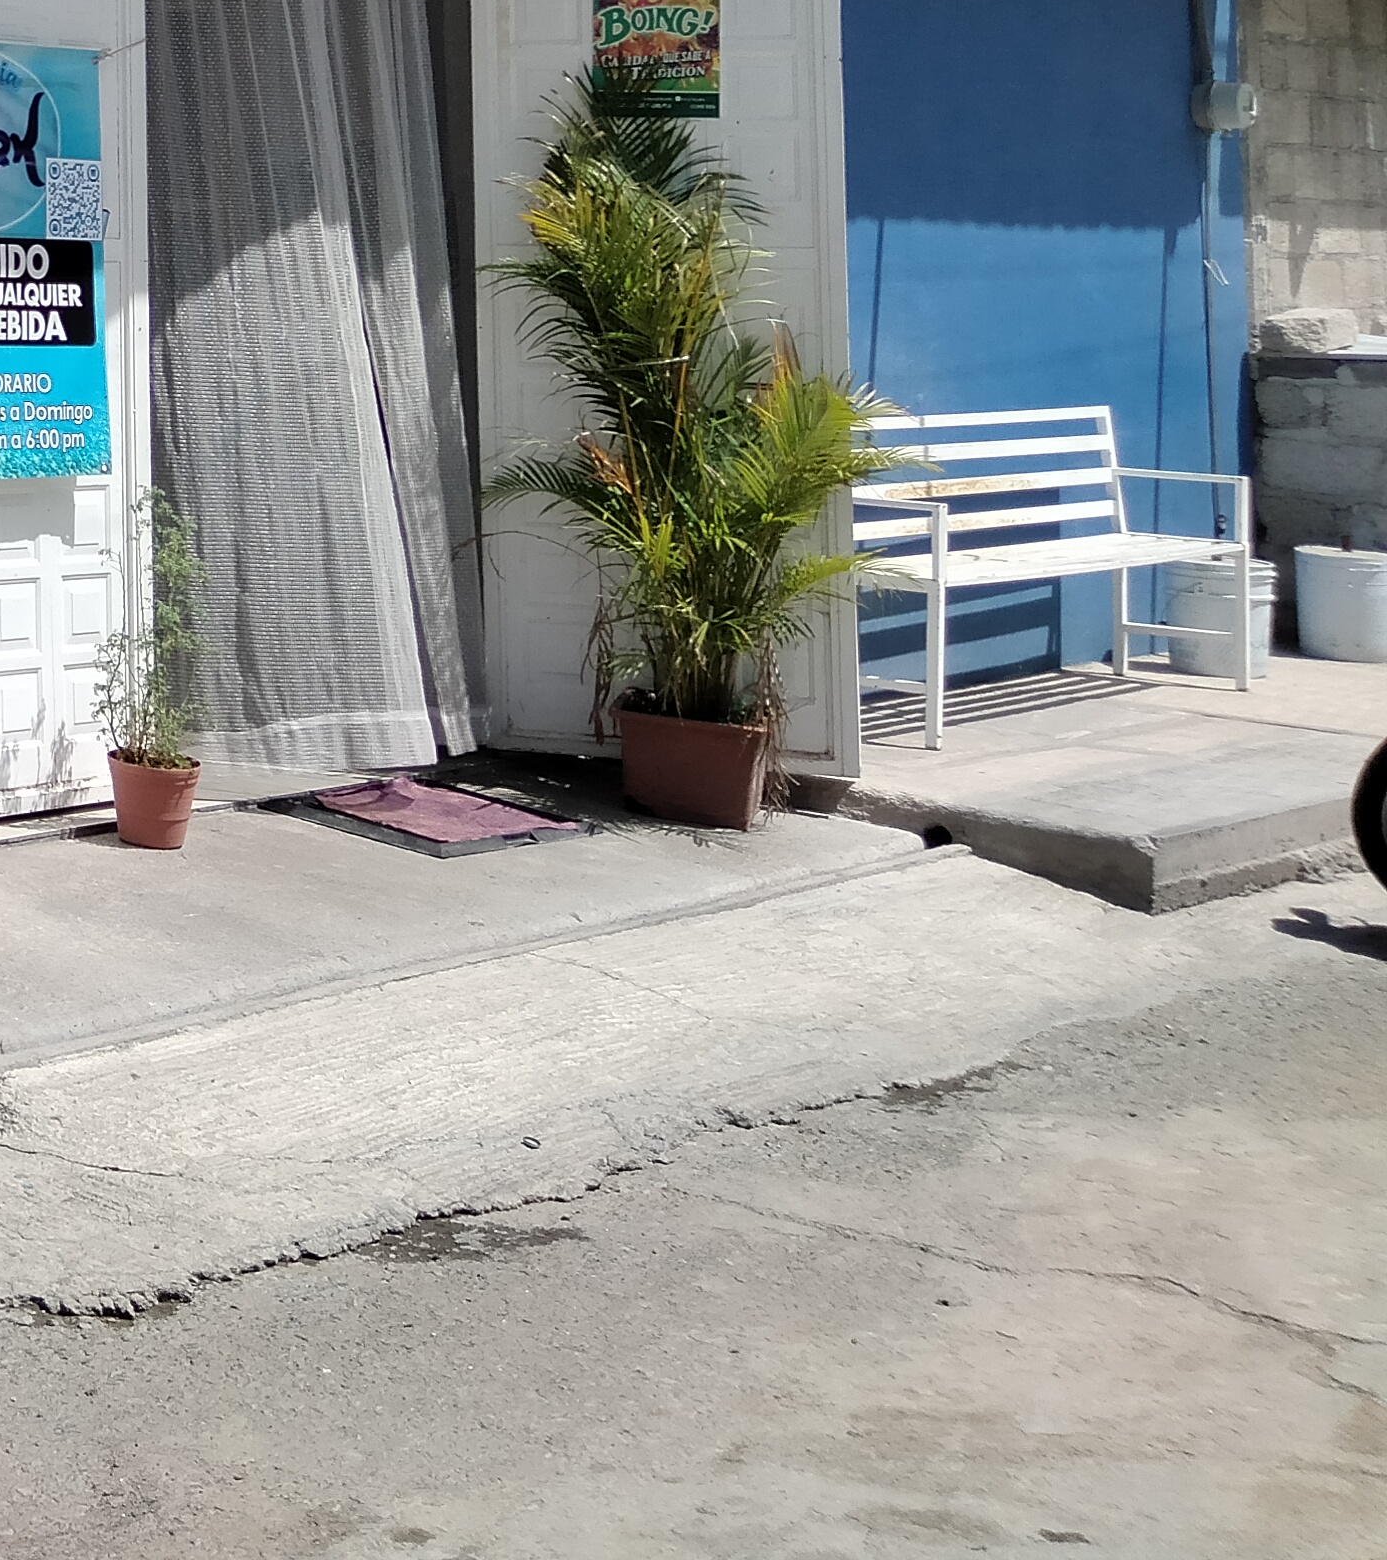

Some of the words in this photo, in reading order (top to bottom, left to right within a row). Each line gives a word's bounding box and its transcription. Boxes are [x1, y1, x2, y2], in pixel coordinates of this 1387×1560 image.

[598, 6, 717, 49] BOING!
[10, 406, 20, 421] a
[24, 401, 93, 424] Domingo
[11, 433, 21, 449] a
[26, 428, 59, 450] 6:00
[63, 431, 85, 452] pm
